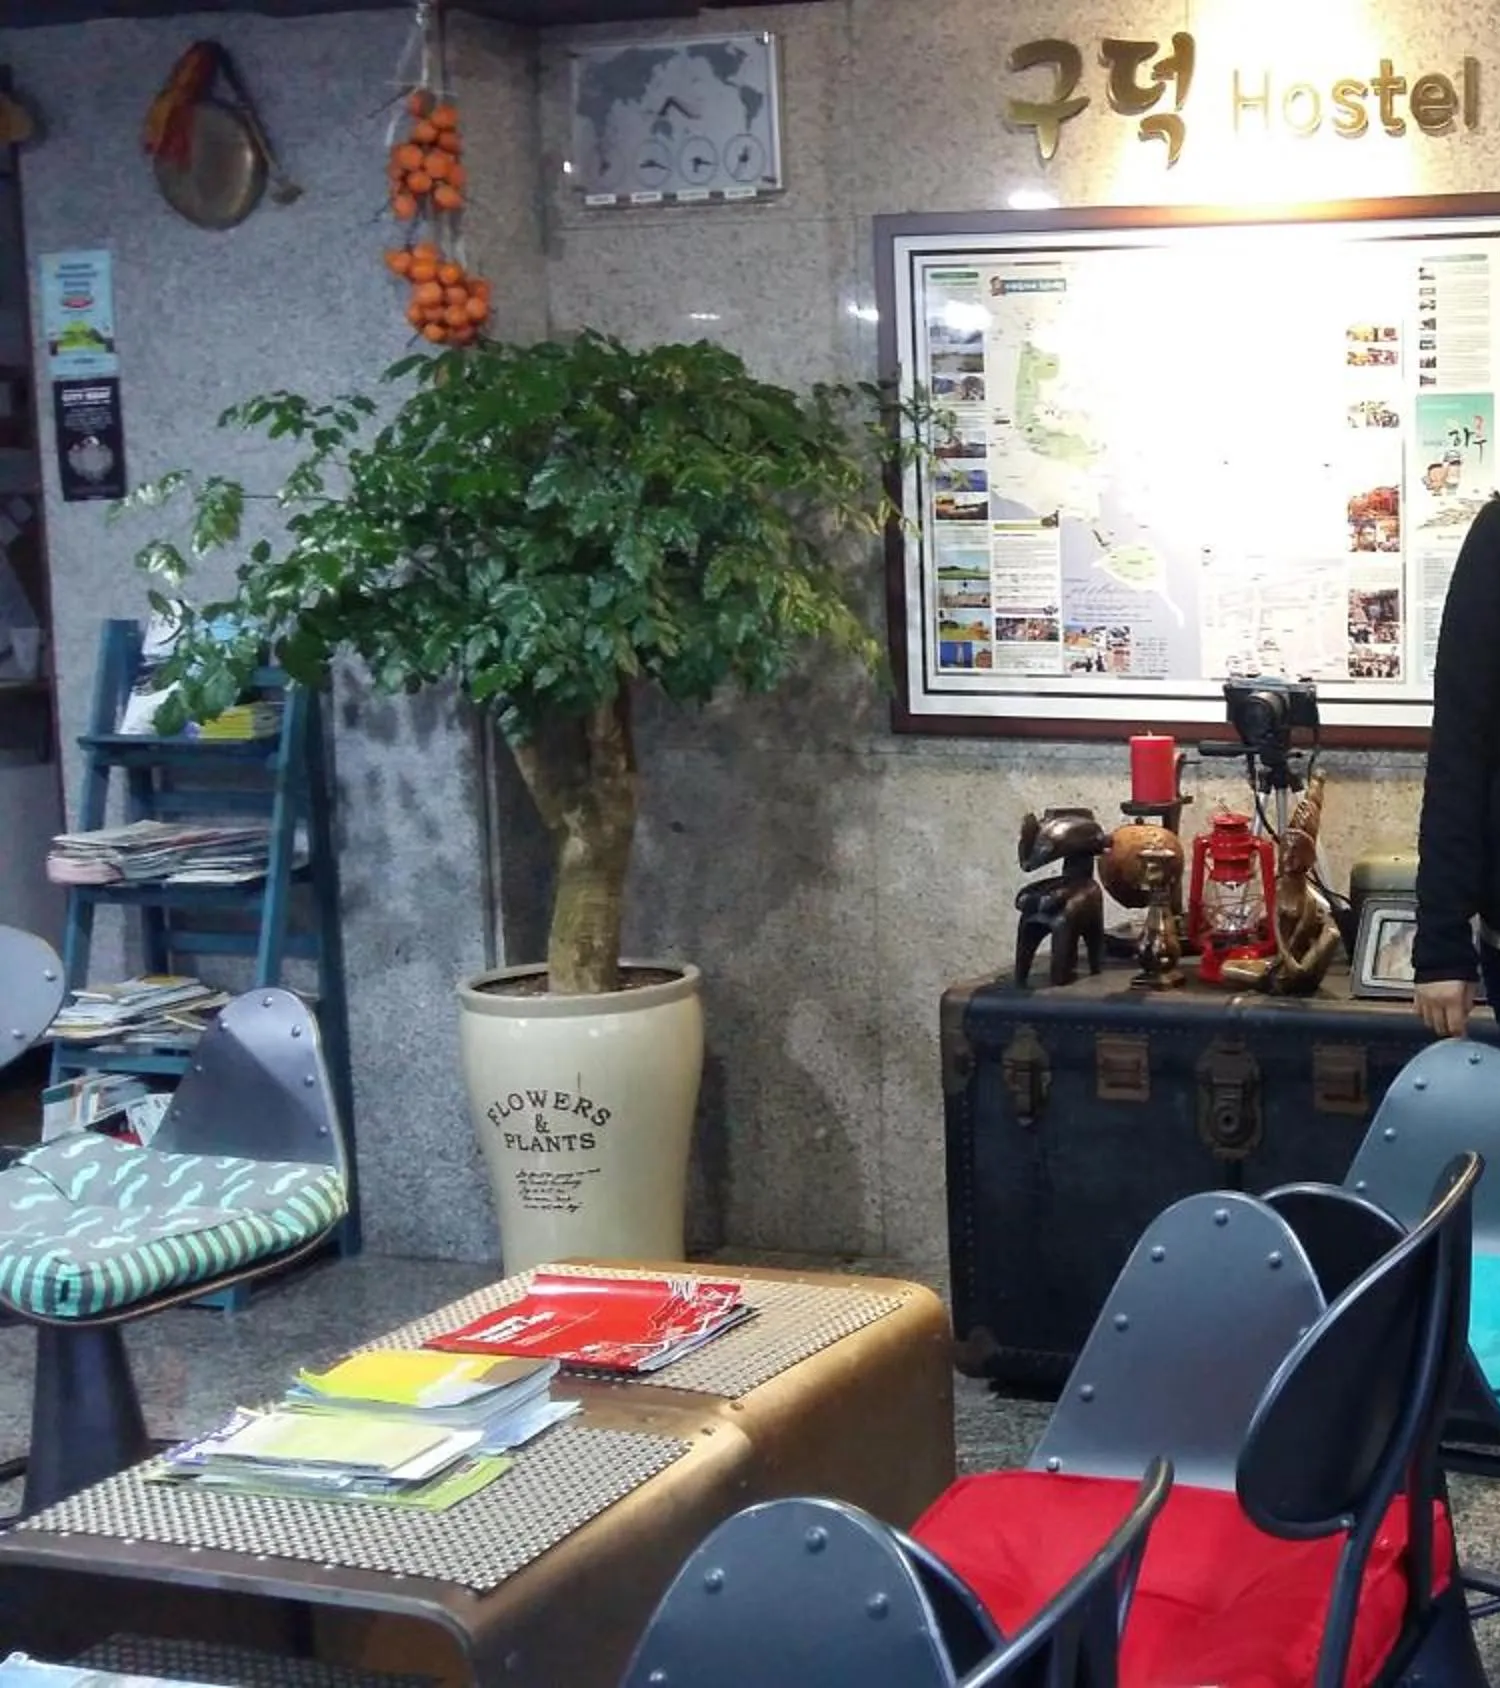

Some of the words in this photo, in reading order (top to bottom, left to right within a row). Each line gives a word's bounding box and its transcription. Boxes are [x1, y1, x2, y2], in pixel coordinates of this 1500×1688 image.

[1004, 31, 1196, 168] 구덕
[1232, 56, 1482, 138] Hostel
[486, 1088, 612, 1127] FLOWERS
[535, 1113, 551, 1134] &
[503, 1132, 596, 1152] PLANTS
